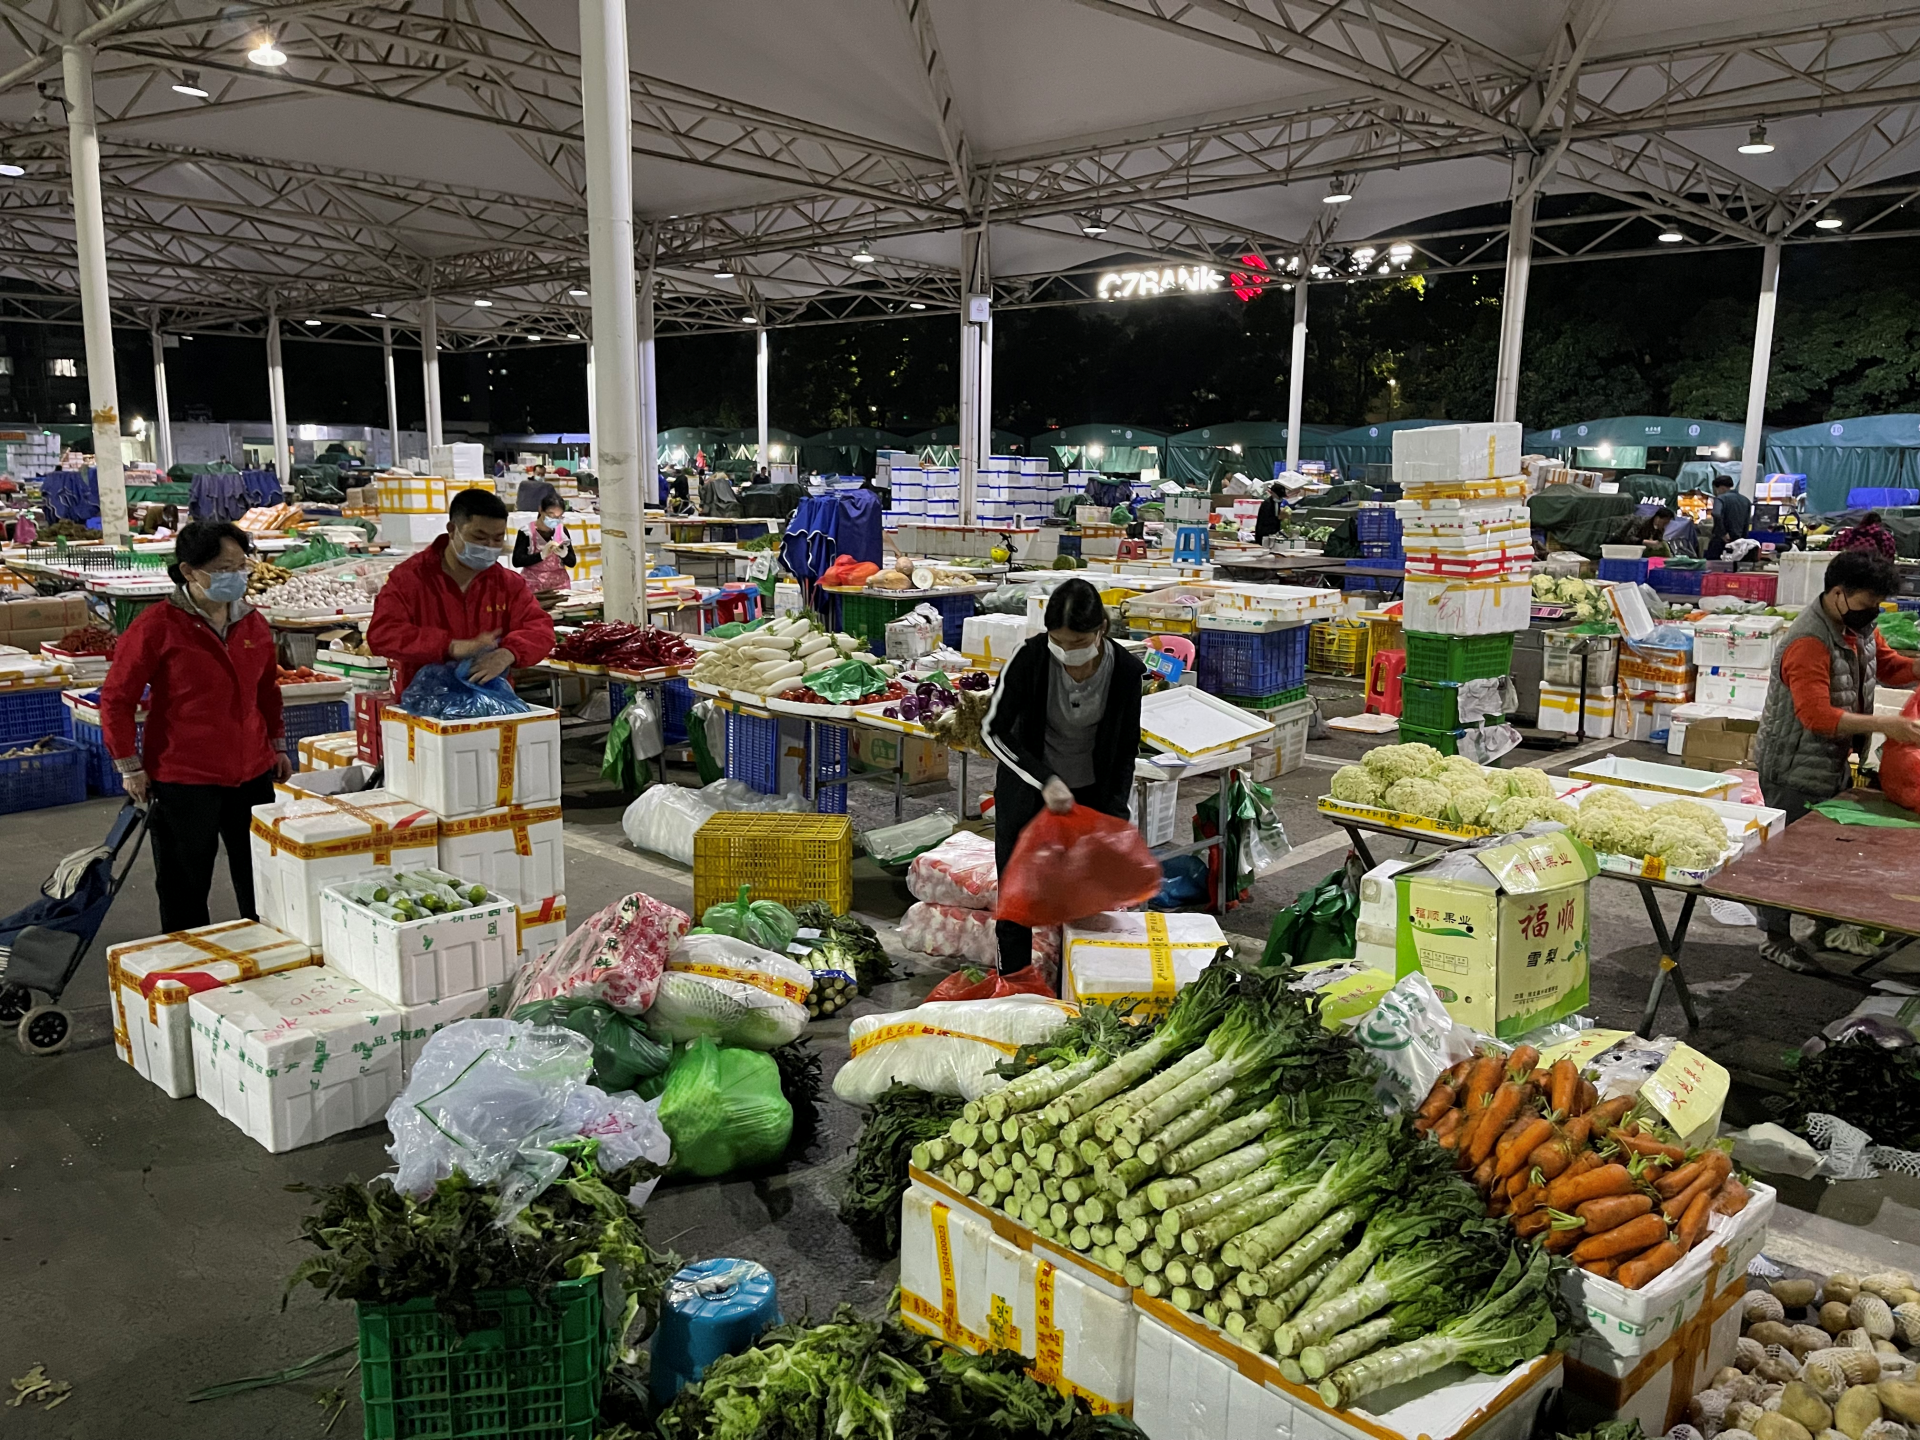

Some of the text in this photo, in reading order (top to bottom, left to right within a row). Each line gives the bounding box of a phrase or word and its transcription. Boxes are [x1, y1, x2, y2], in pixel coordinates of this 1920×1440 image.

[1514, 852, 1573, 875] 福顺果业
[1414, 906, 1473, 926] 福顺果业
[1518, 898, 1576, 941] 福顺
[1526, 947, 1560, 968] 雪梨
[938, 1224, 953, 1282] 13602400023
